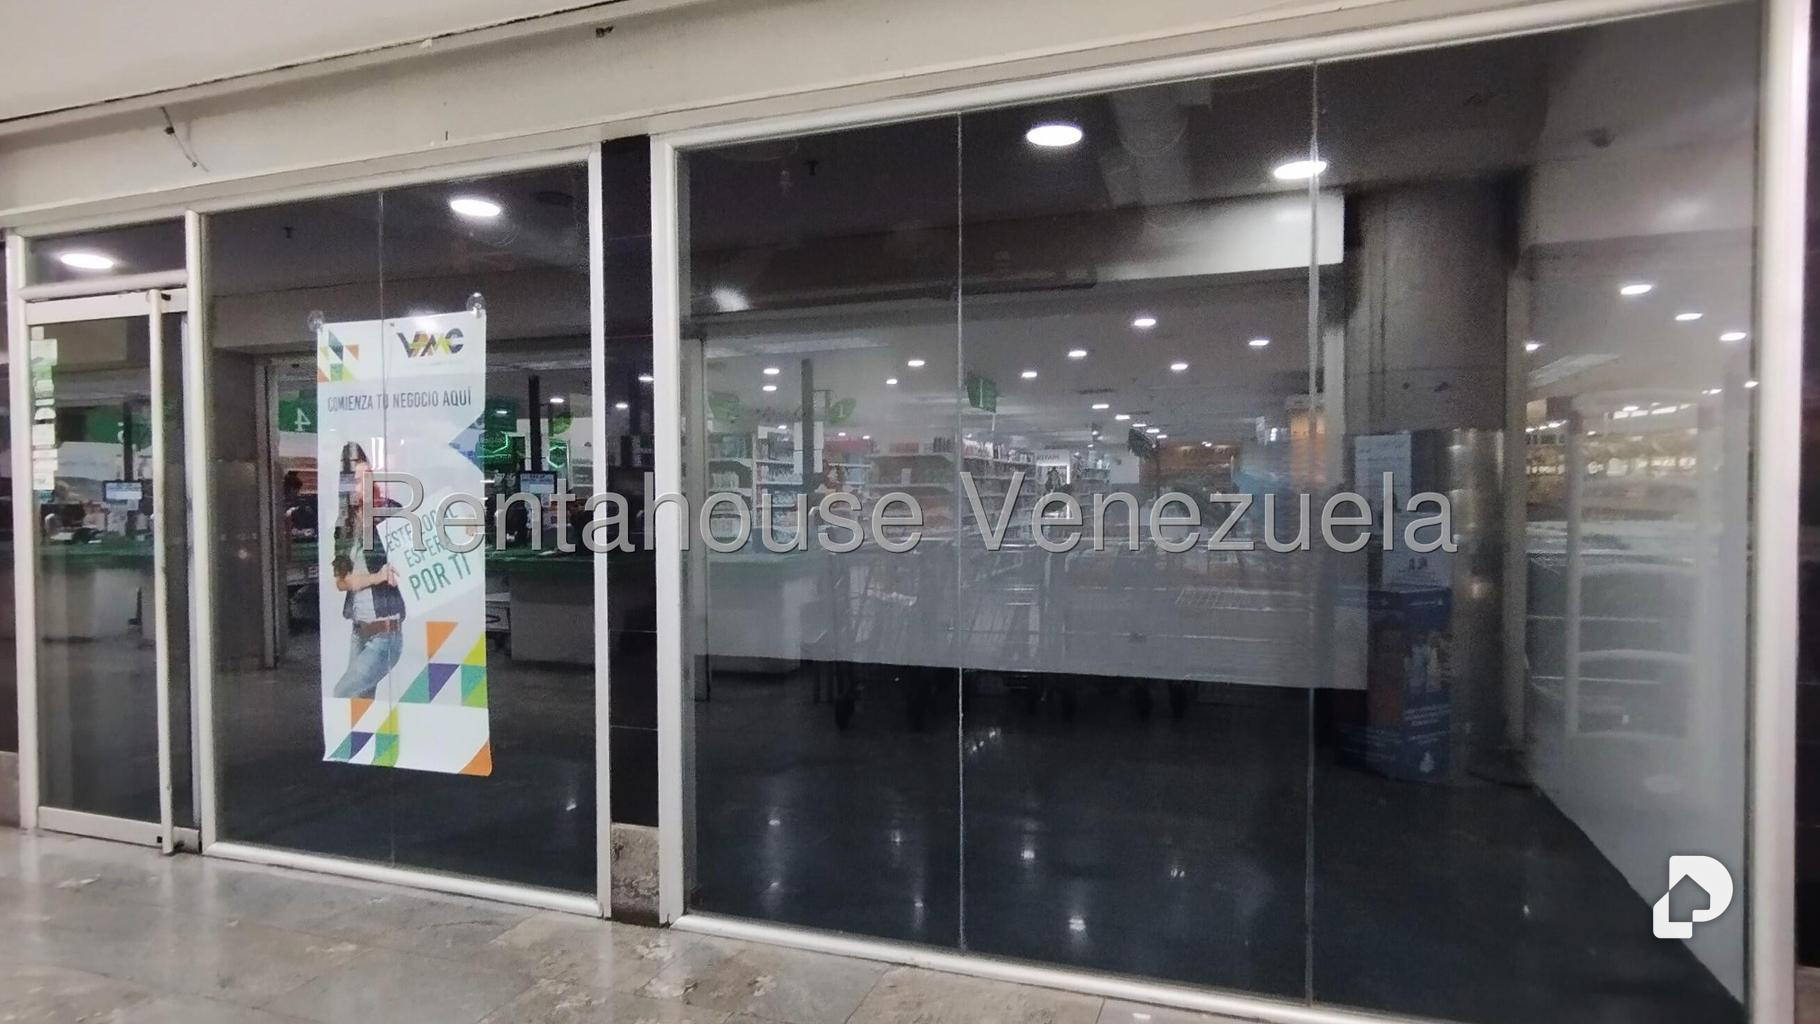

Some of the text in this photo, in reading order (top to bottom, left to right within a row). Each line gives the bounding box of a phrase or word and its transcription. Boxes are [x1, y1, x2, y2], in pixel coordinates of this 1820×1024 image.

[328, 395, 373, 412] COMIENZA
[393, 391, 439, 408] NEGOCIO
[442, 386, 471, 407] AQUÍ
[408, 552, 471, 600] POR TI
